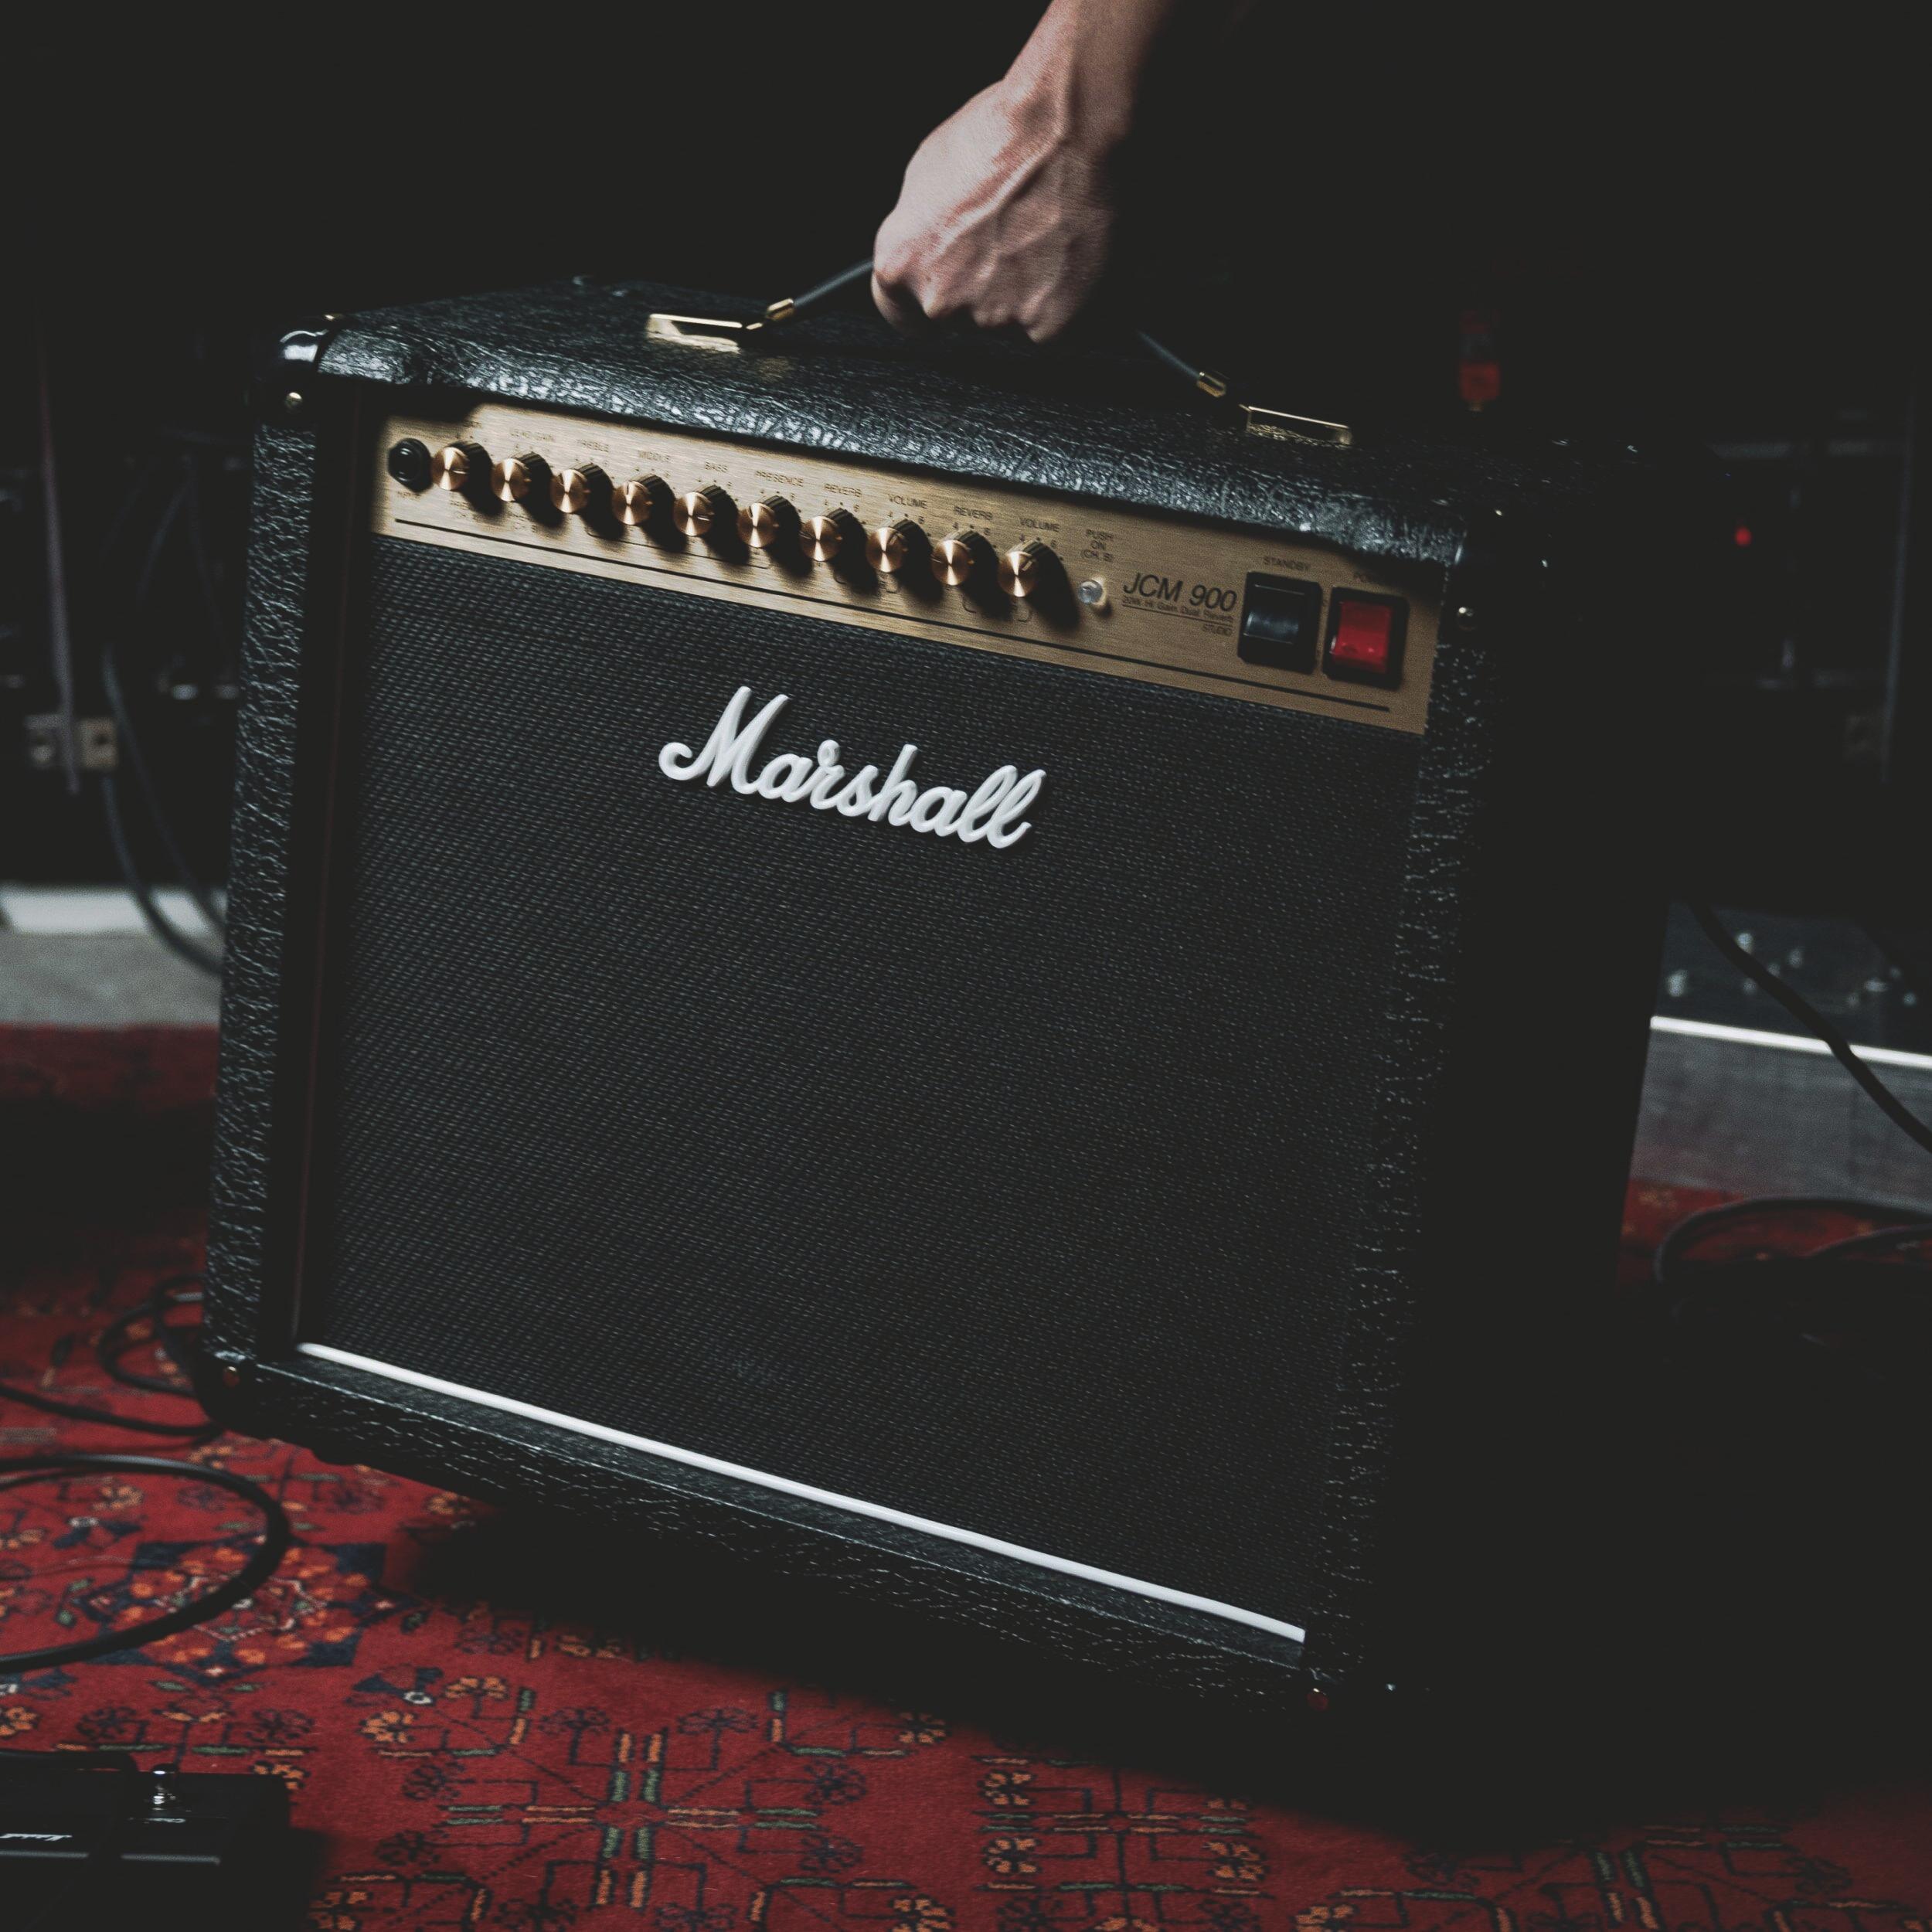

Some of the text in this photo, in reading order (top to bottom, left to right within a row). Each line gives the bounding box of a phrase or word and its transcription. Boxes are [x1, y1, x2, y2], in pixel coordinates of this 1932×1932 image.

[704, 461, 729, 473] BASS
[754, 470, 804, 488] PRESENCE
[823, 483, 863, 498] REVERB
[888, 494, 928, 509] VOLUME
[953, 505, 993, 521] REVERB
[1019, 517, 1060, 532] VOLUME
[1090, 539, 1106, 550] ON
[1263, 556, 1311, 571] STANDBY
[1123, 573, 1238, 612] JCM 900
[658, 685, 1047, 849] Marshall
